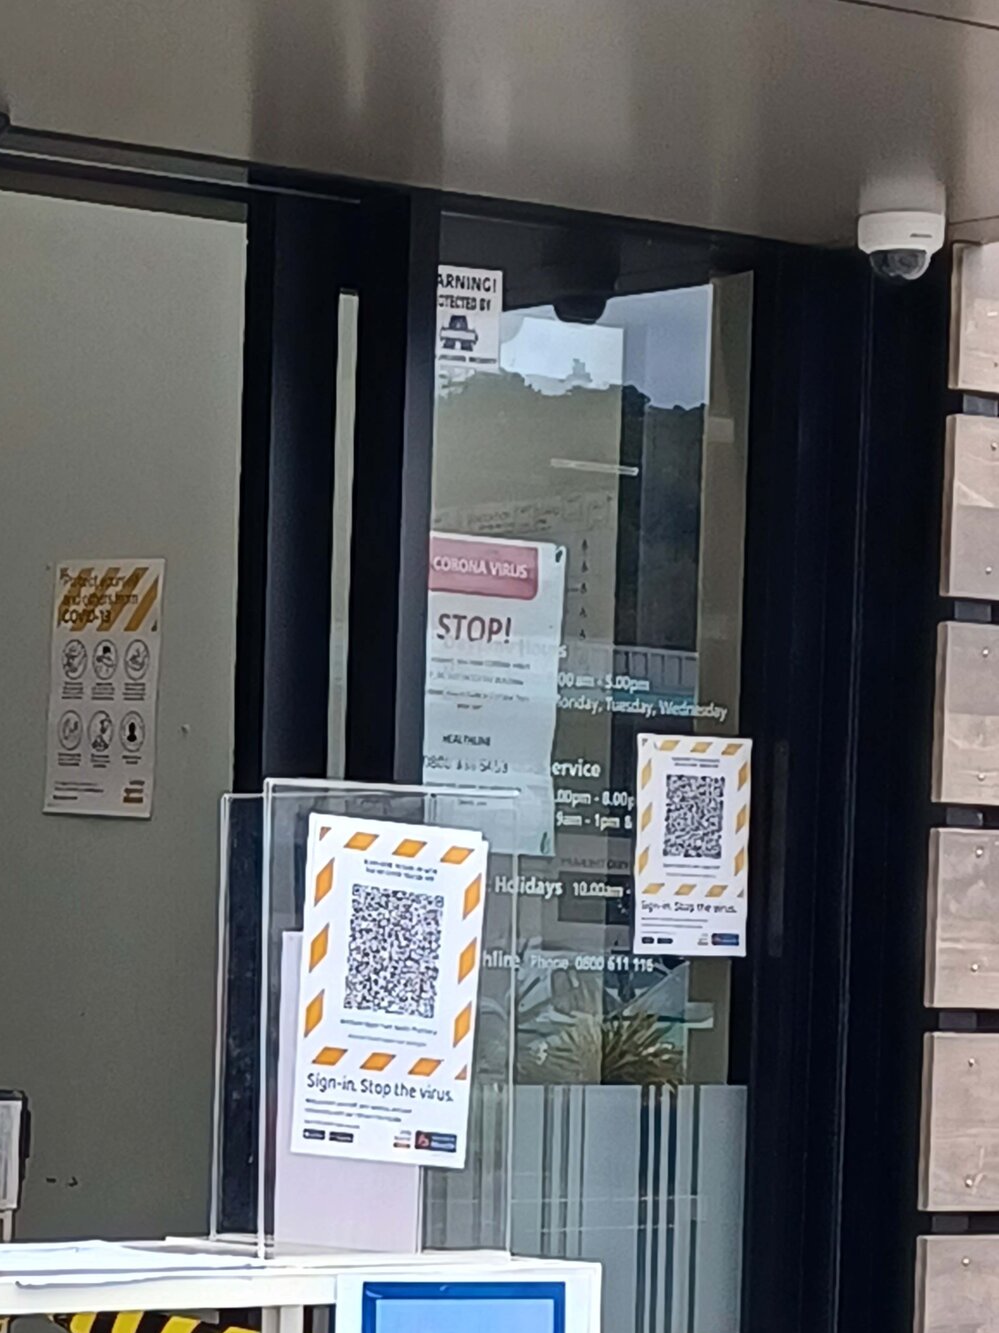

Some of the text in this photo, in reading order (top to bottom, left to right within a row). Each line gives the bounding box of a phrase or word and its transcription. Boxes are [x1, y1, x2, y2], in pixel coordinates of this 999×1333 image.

[438, 273, 497, 294] ARNING!
[438, 294, 491, 311] OTECTED BY
[432, 556, 528, 579] CORONA VIRUS
[436, 612, 512, 644] STOP!
[604, 673, 650, 694] 5.00pm
[557, 693, 603, 715] onday,
[605, 696, 657, 719] Tuesday,
[657, 698, 728, 723] Wednesday
[551, 758, 601, 778] ervice
[601, 790, 635, 812] 8.00p
[482, 950, 521, 970] hline
[606, 956, 629, 972] 611
[359, 1077, 393, 1099] Stop
[393, 1081, 418, 1100] the
[419, 1084, 455, 1103] virus.
